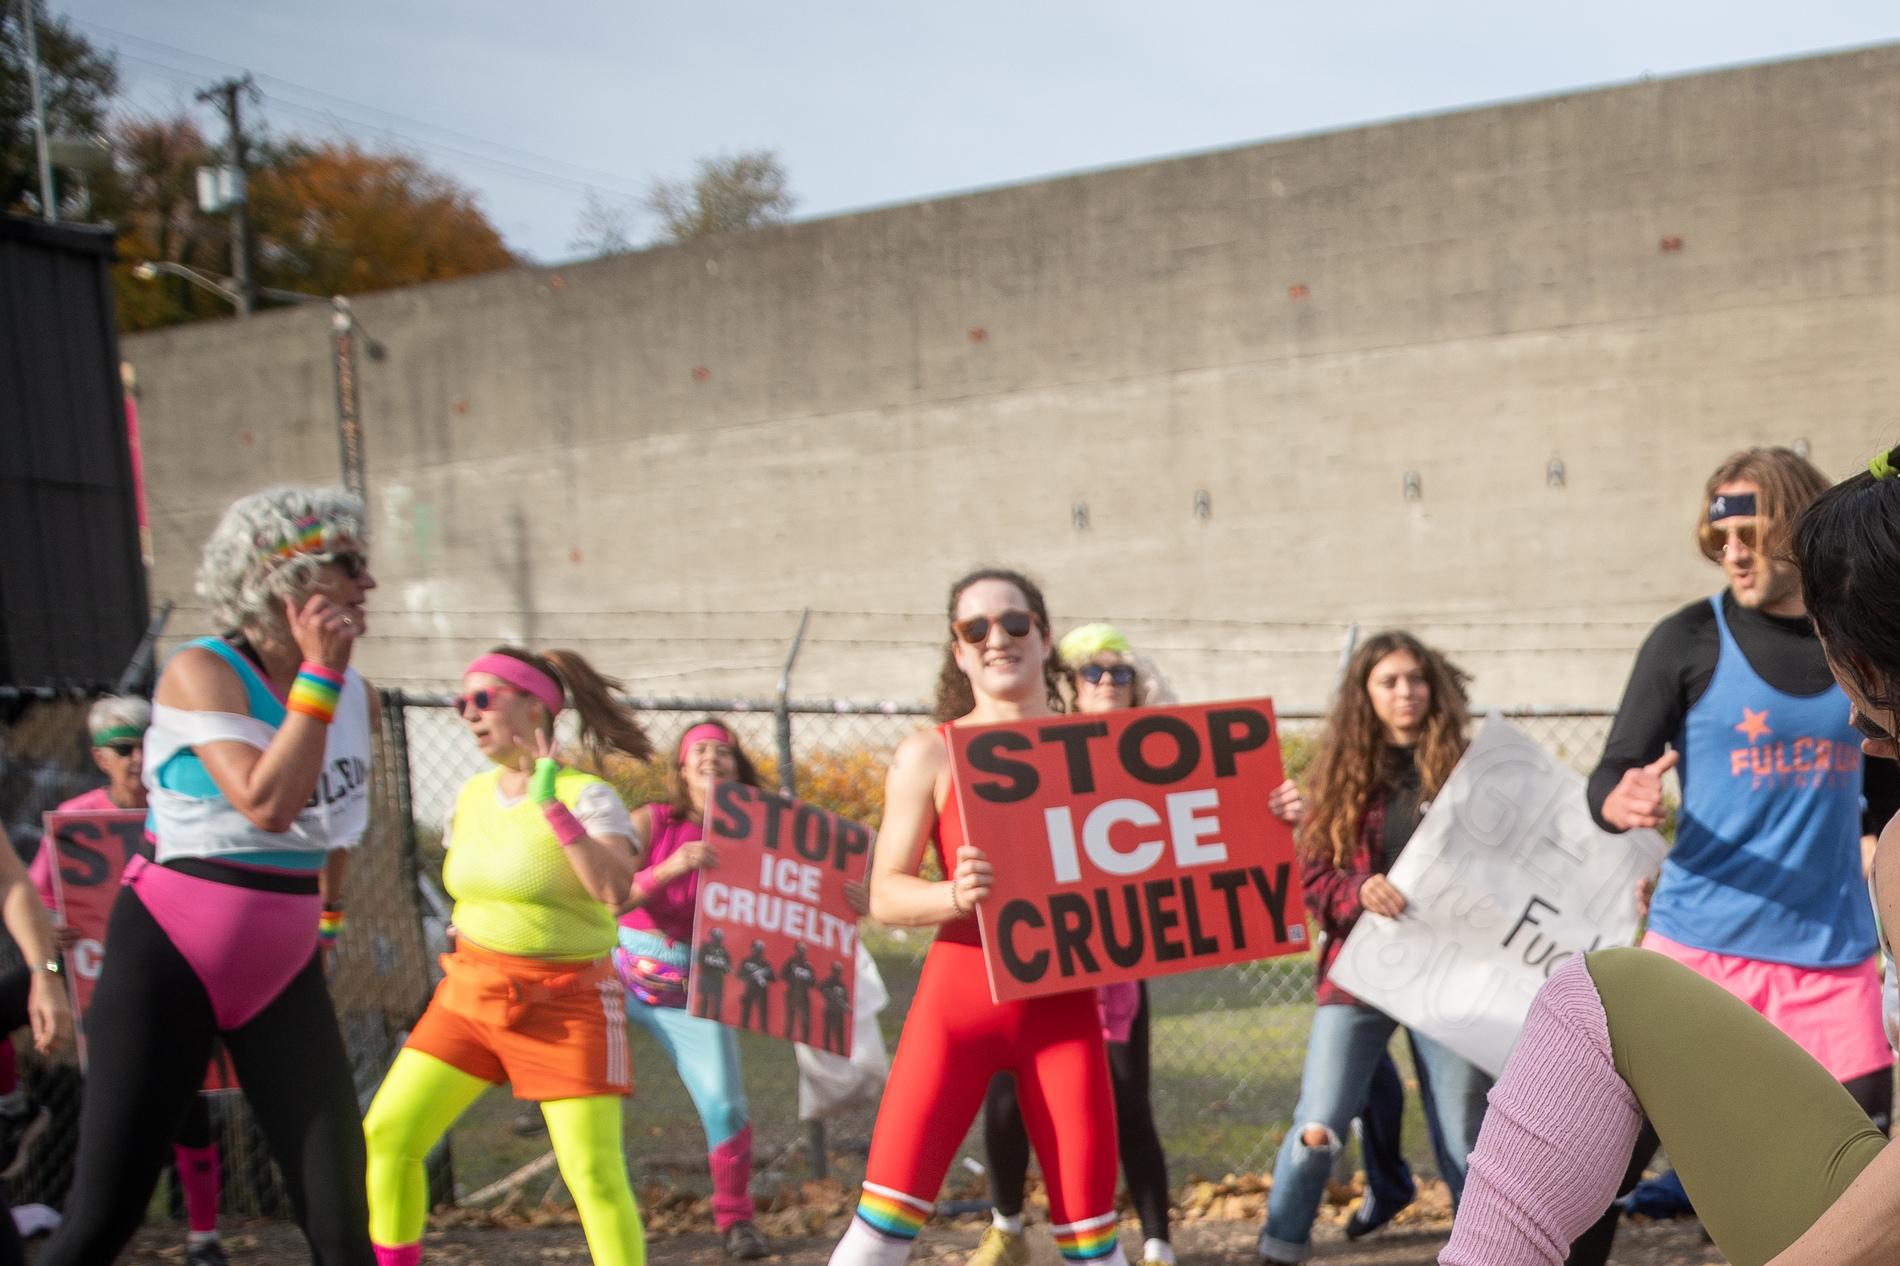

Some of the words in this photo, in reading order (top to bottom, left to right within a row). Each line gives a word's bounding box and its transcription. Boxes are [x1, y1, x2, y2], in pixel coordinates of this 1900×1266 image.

[966, 707, 1270, 804] STOP
[58, 822, 151, 886] ST
[712, 782, 868, 872] STOP
[1044, 788, 1228, 884] ICE
[703, 881, 857, 958] CRUELTY
[760, 853, 823, 904] ICE
[996, 862, 1291, 983] CRUELTY
[1353, 920, 1541, 1029] OU
[1502, 894, 1618, 979] Fuc
